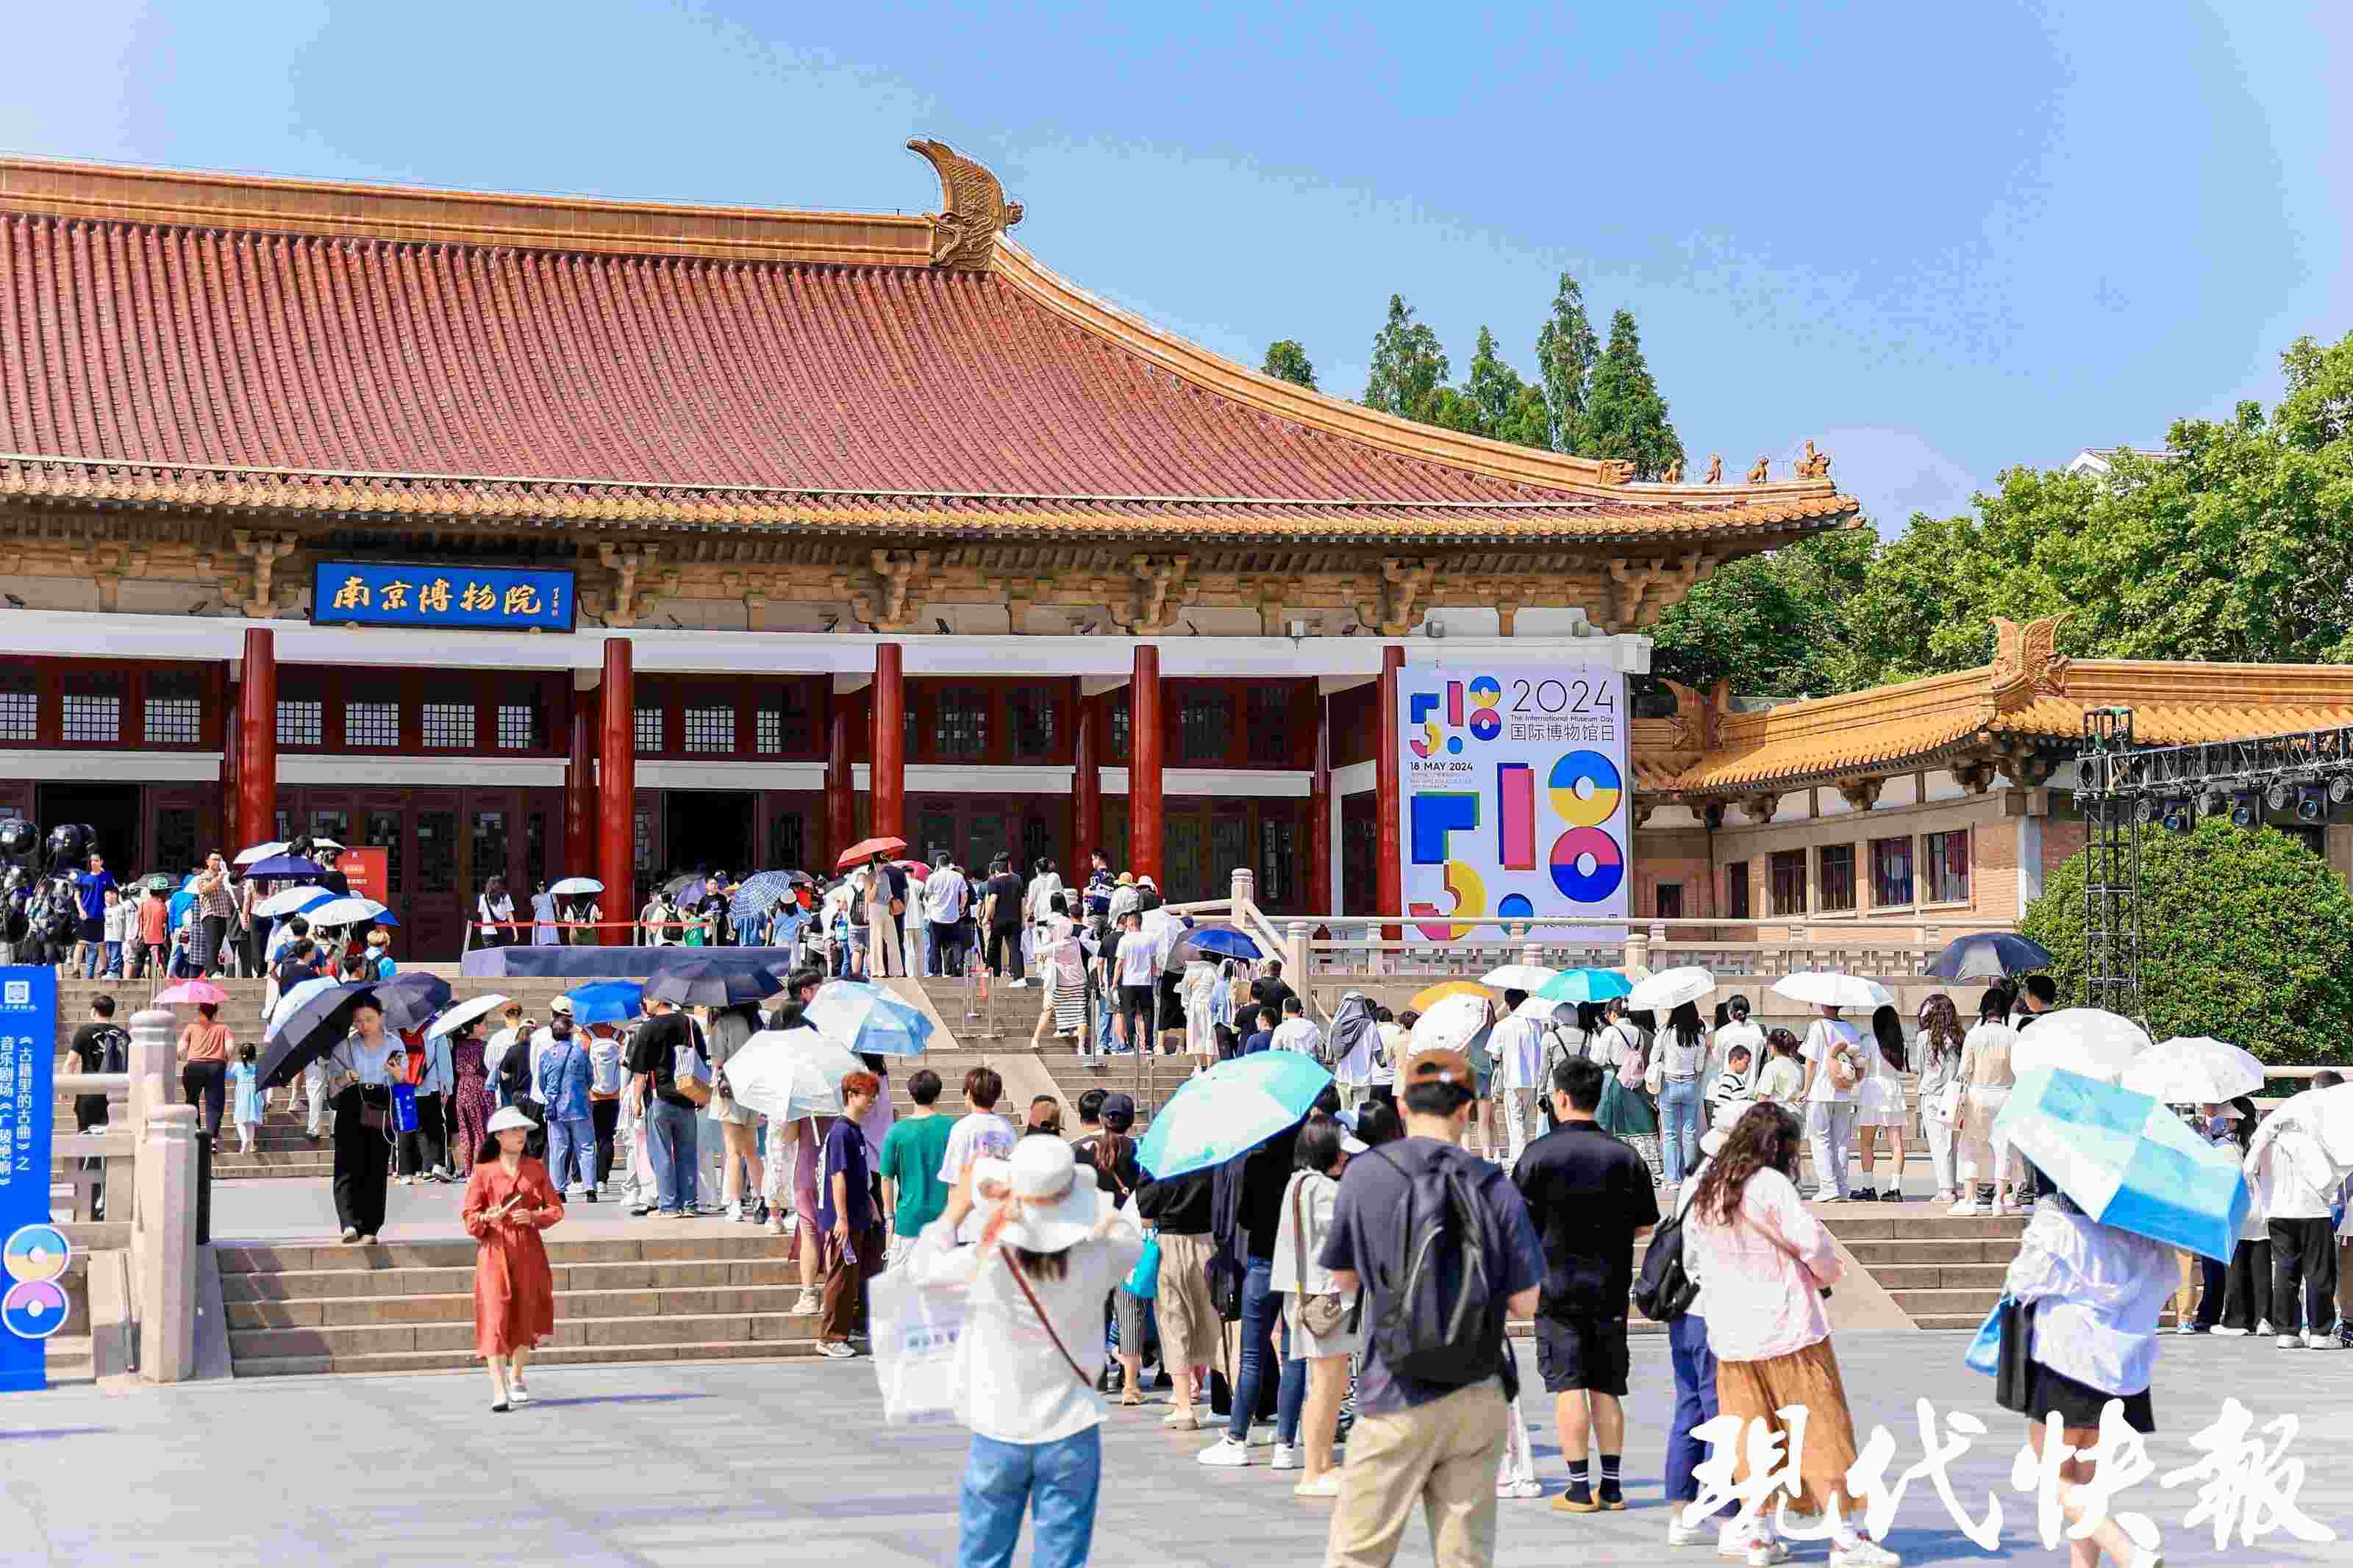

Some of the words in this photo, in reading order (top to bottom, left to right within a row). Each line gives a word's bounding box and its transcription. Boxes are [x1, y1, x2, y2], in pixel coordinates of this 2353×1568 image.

[331, 576, 543, 615] 南京博物院
[1512, 679, 1615, 714] 2024
[1510, 723, 1615, 742] 国际博物馆日
[1424, 762, 1446, 771] MAY
[1449, 762, 1474, 771] 2024
